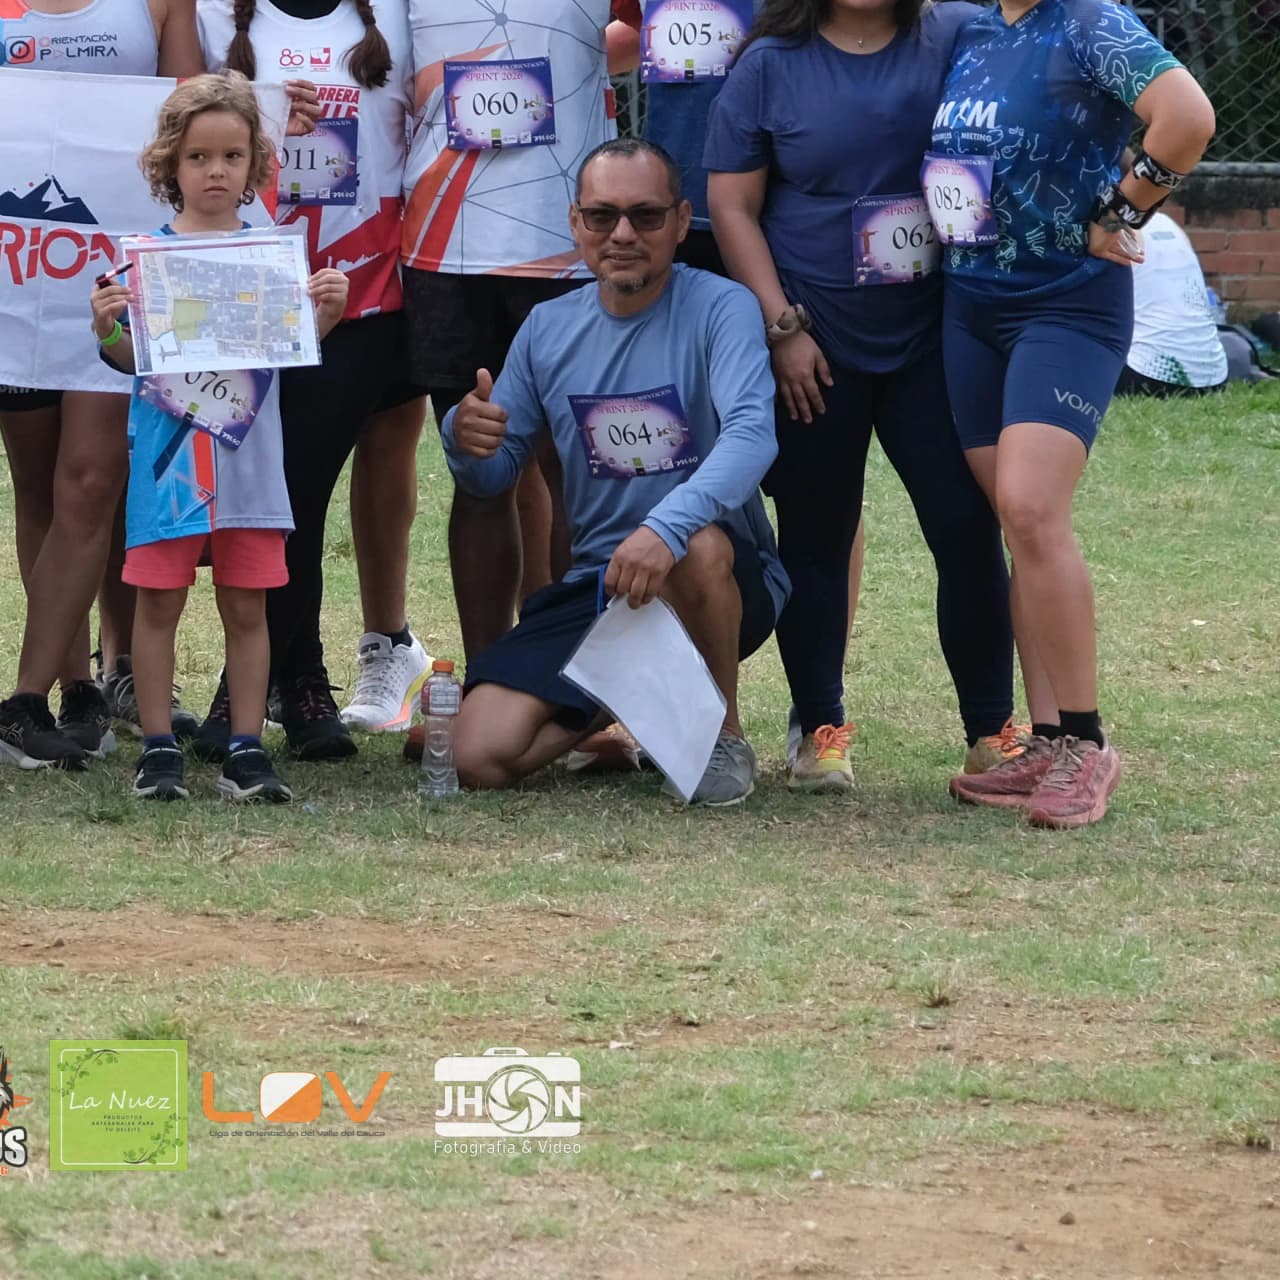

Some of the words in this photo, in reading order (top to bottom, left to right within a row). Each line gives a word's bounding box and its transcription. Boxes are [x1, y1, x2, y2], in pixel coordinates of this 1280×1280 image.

[668, 22, 712, 46] 005
[465, 70, 498, 81] SPRINT
[472, 92, 518, 116] 060
[934, 185, 963, 211] 082
[884, 204, 922, 217] SPRINT
[892, 222, 934, 250] 062
[608, 421, 652, 446] 064
